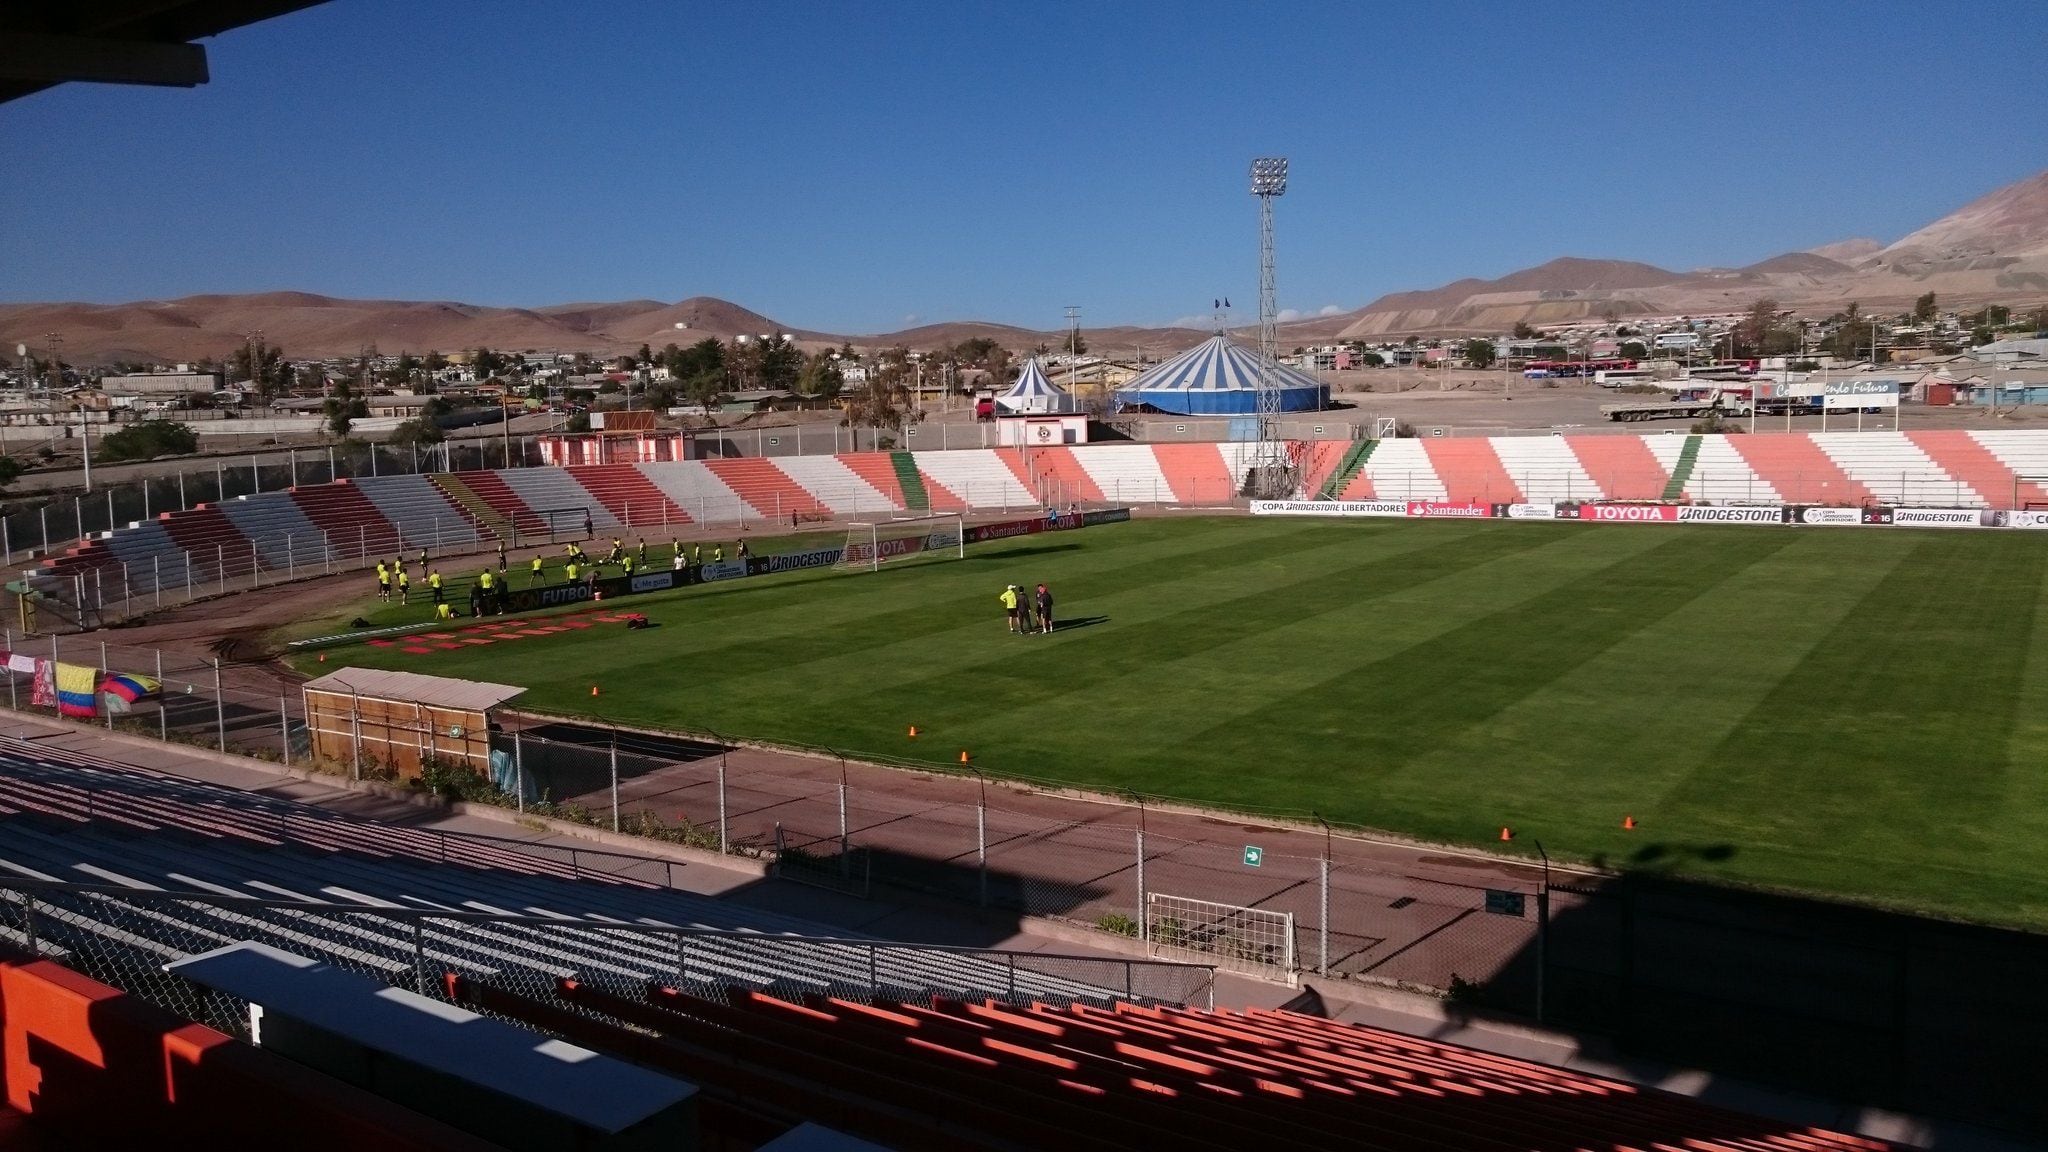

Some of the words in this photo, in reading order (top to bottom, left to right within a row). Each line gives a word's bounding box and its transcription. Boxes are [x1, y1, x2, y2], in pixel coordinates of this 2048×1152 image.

[1852, 381, 1889, 394] Futuro
[1262, 502, 1285, 511] COPA
[1285, 502, 1341, 512] BRIDGESTONE
[1342, 503, 1407, 513] LIBERTADORES
[1426, 503, 1485, 516] Santander
[1594, 506, 1663, 520] TOYOTA
[1679, 507, 1781, 522] BRIDGESTONE
[1863, 514, 1891, 522] 2016
[1896, 511, 1975, 522] BRIDGESTONE
[2036, 514, 2048, 524] C
[990, 522, 1029, 537] Santander
[860, 540, 907, 558] TOYOTA
[542, 586, 593, 605] FUTBOL
